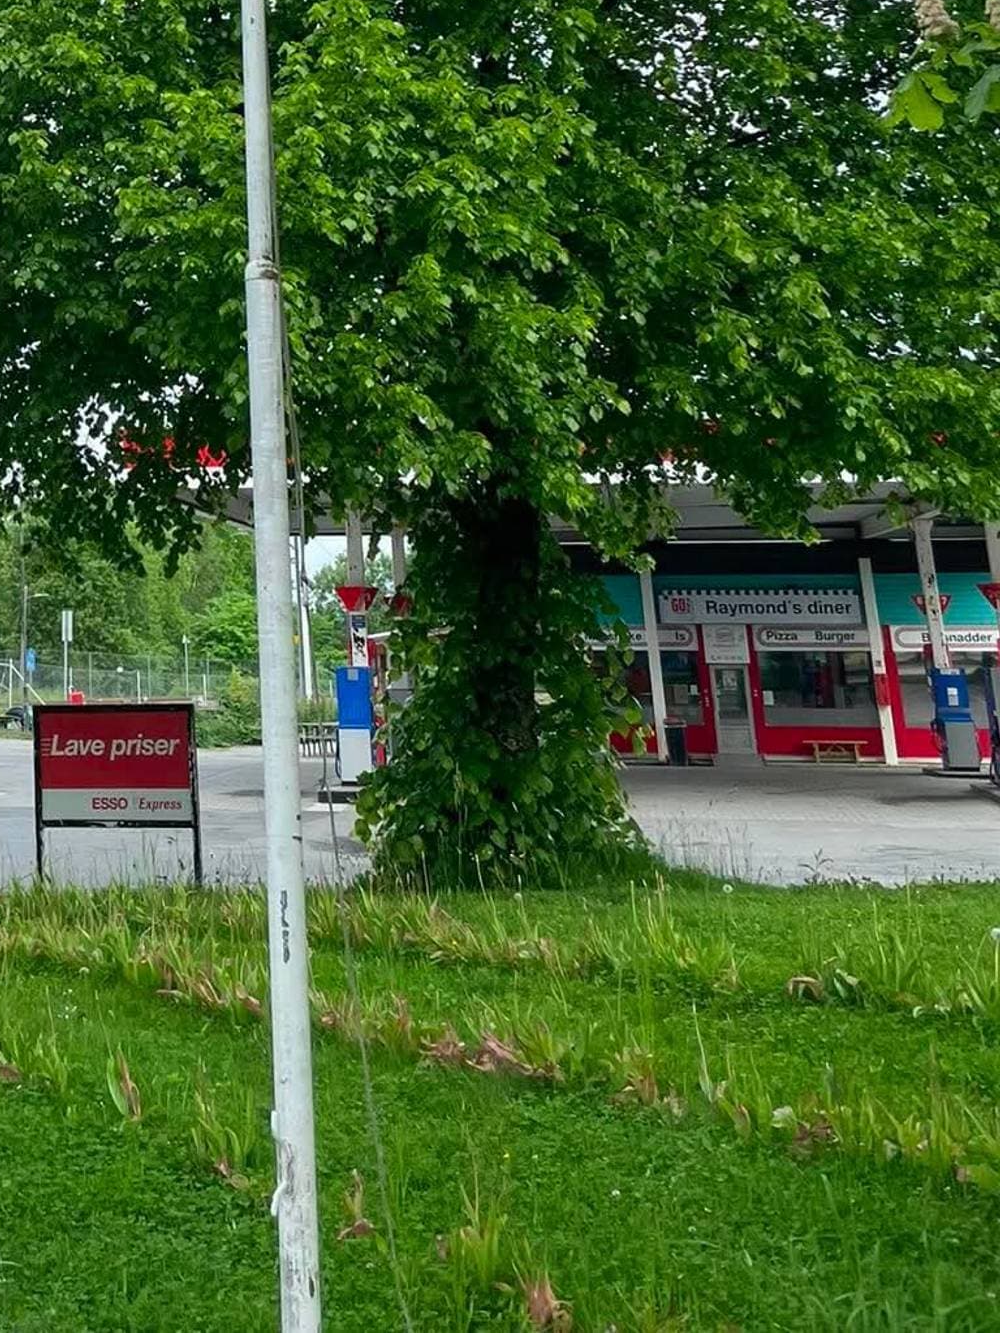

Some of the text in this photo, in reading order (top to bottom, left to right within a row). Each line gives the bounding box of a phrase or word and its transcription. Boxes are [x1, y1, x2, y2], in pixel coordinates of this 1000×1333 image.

[706, 600, 852, 617] Raymond's diner
[766, 630, 855, 644] Pizza Burger
[51, 733, 181, 761] Lave priser
[92, 797, 182, 813] ESSO Express
